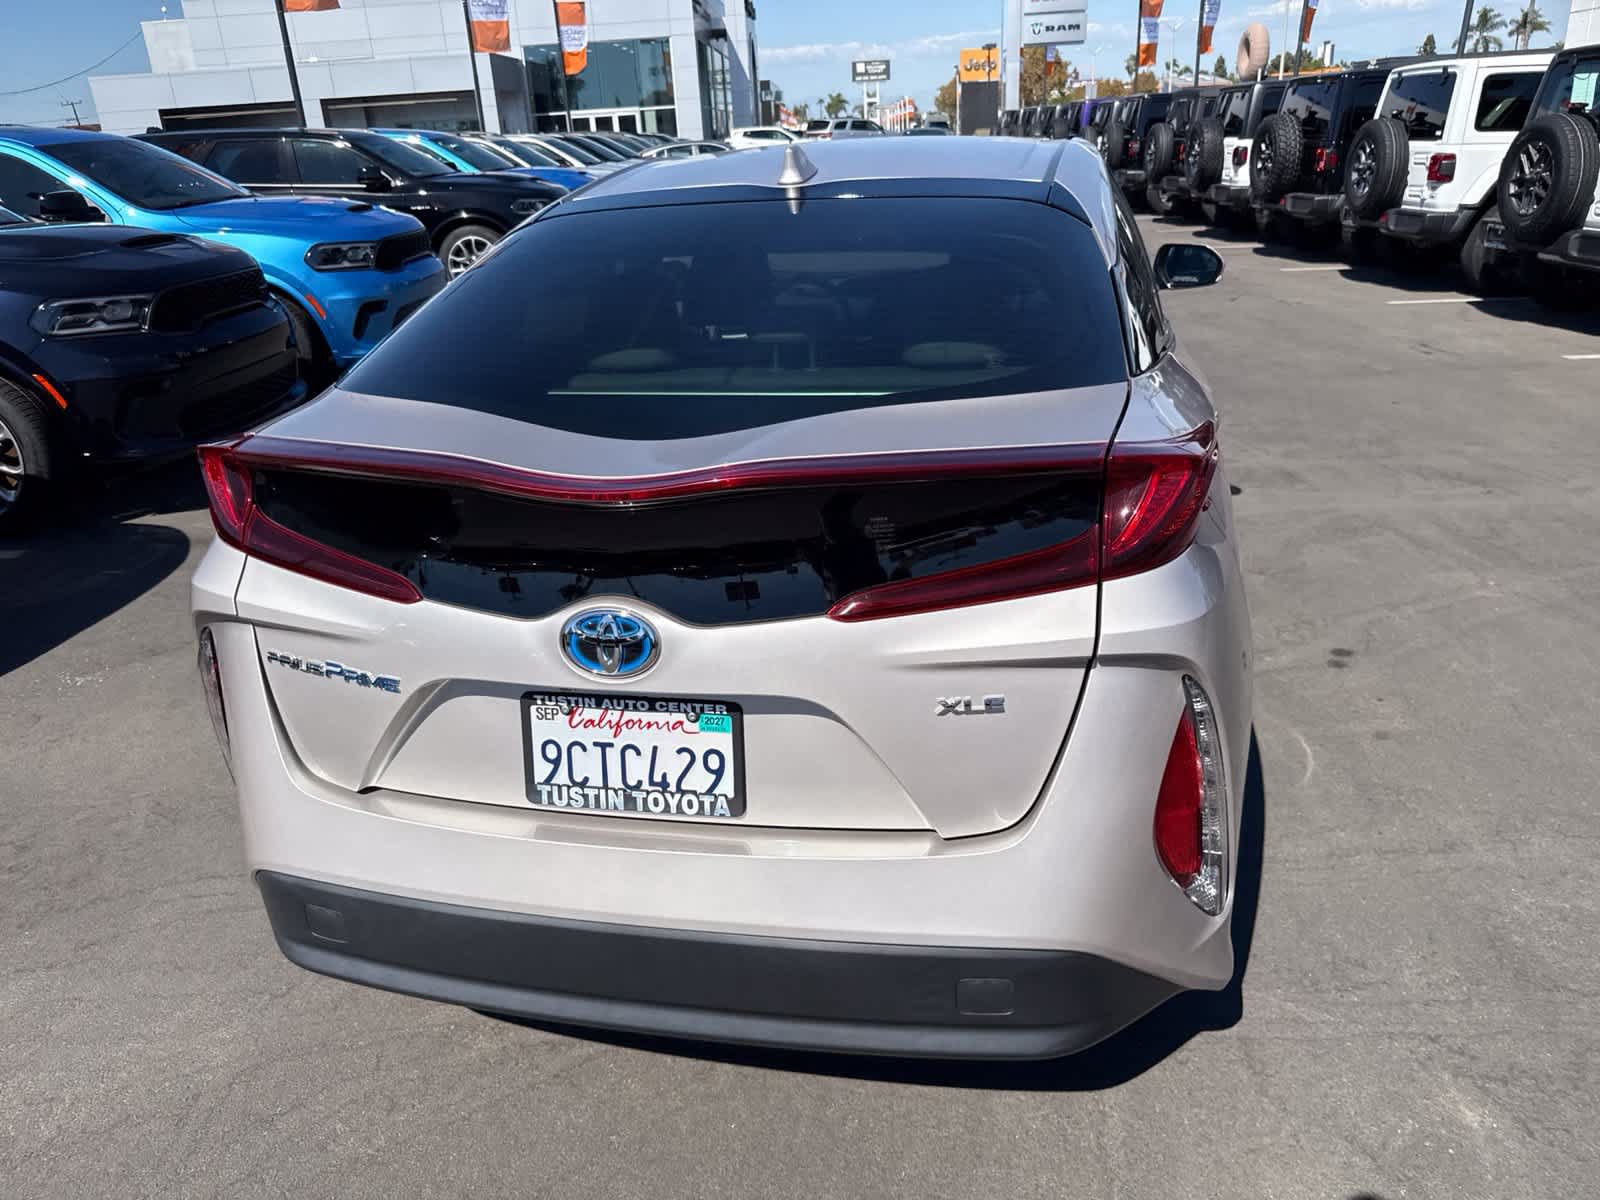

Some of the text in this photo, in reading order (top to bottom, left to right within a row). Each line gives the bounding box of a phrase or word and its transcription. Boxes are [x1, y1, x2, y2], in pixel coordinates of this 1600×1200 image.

[1045, 24, 1080, 32] RAM
[964, 58, 997, 72] Jeep
[533, 695, 727, 714] TUSTIN AUTO CENTER
[536, 707, 559, 721] SEP
[934, 694, 1006, 716] XLE
[566, 706, 700, 738] California
[704, 716, 725, 726] 2027
[541, 739, 726, 795] 9CTC429
[536, 784, 731, 817] TUSTIN TOYOTA
